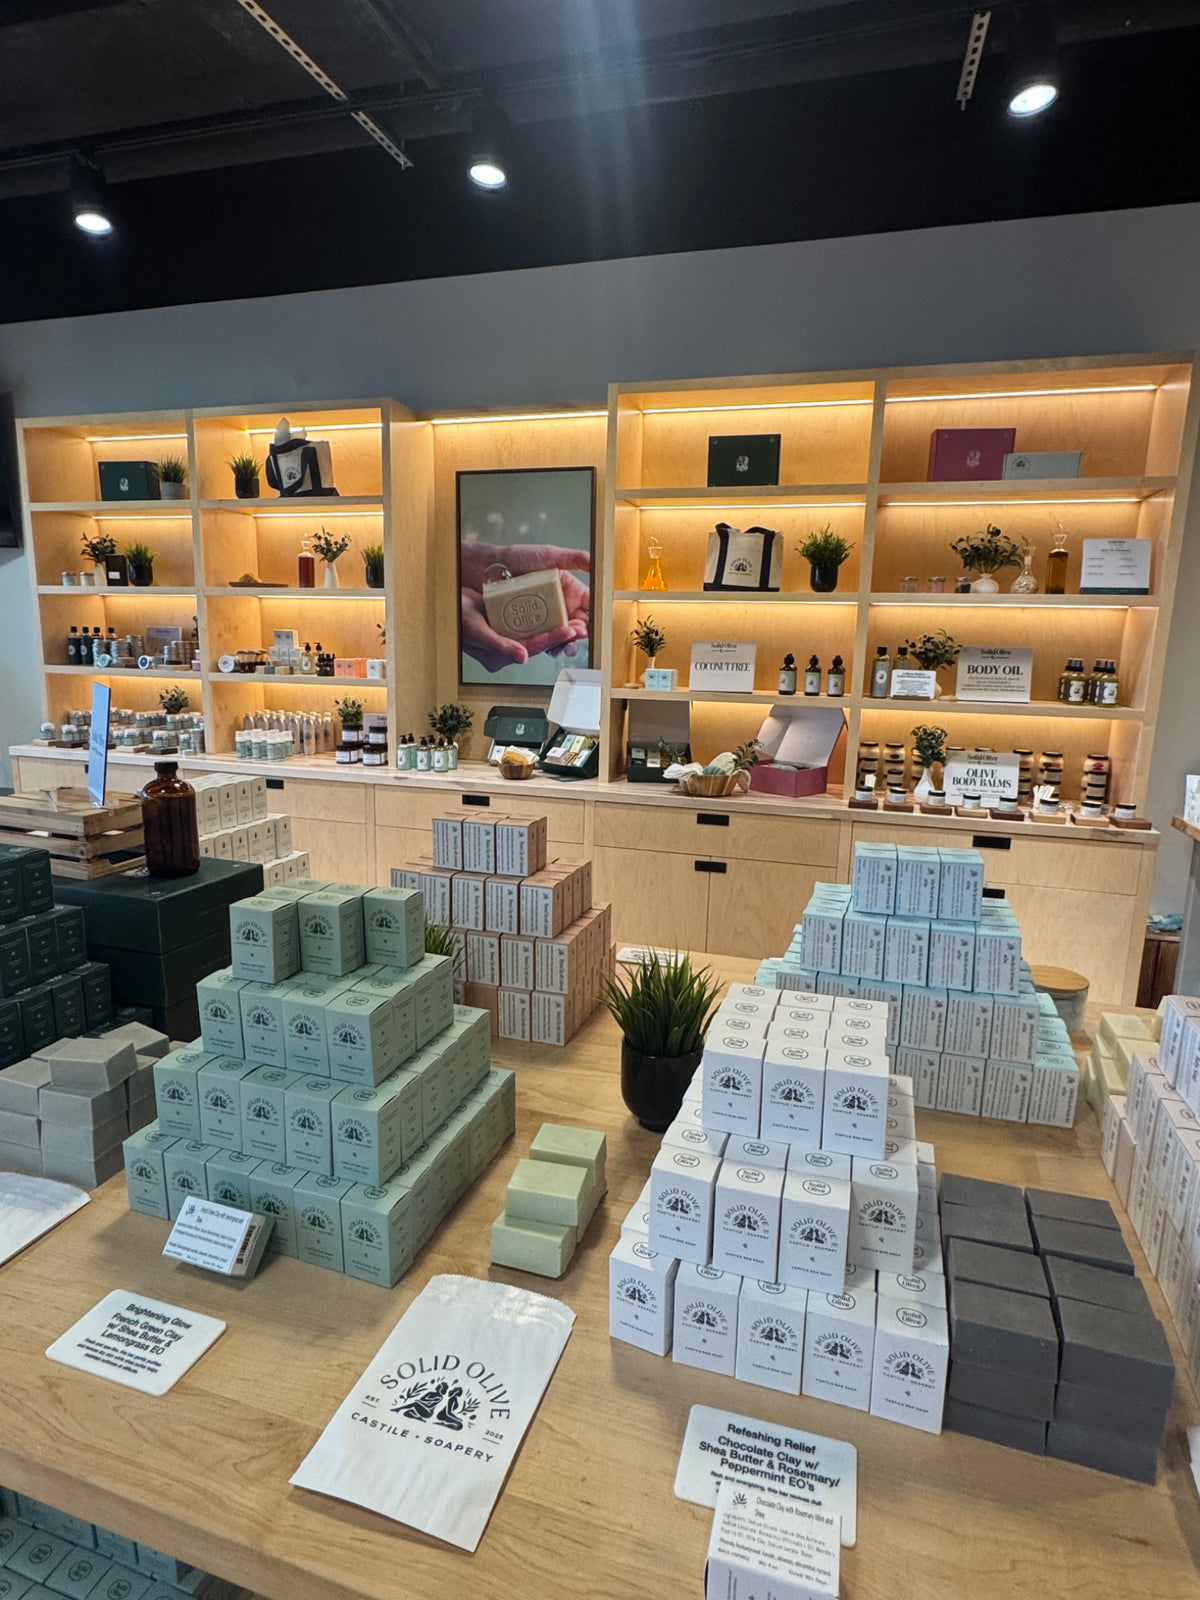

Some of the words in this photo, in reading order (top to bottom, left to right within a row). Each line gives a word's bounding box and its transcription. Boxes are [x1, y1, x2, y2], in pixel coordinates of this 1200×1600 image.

[511, 600, 538, 616] Solid
[512, 615, 540, 628] Olive
[695, 662, 731, 672] COCONUT
[732, 663, 750, 672] FREE
[968, 664, 1000, 676] BODY
[1002, 664, 1023, 676] OIL
[952, 777, 977, 786] BODY
[980, 780, 1012, 788] BALMS
[966, 768, 998, 778] OLIVE
[711, 1067, 730, 1080] SOLID
[732, 1068, 751, 1086] OLIVE
[771, 1079, 792, 1092] SOLID
[794, 1080, 814, 1097] OLIVE
[834, 1087, 855, 1101] SOLID
[857, 1088, 878, 1105] OLIVE
[659, 1188, 679, 1201] SOLID
[681, 1190, 700, 1210] OLIVE
[860, 1200, 883, 1214] SOLID
[885, 1202, 906, 1220] OLIVE
[724, 1204, 746, 1218] SOLID
[748, 1206, 769, 1226] OLIVE
[791, 1218, 814, 1232] SOLID
[816, 1219, 838, 1240] OLIVE
[618, 1278, 636, 1290] SOLID
[638, 1280, 656, 1300] OLIVE
[126, 1304, 170, 1324] Brightening
[171, 1318, 192, 1330] Glow
[684, 1301, 704, 1314] SOLID
[707, 1303, 728, 1322] OLIVE
[107, 1322, 118, 1330] w/
[118, 1325, 138, 1337] Shea
[140, 1332, 164, 1346] Butter
[164, 1340, 173, 1348] &
[112, 1312, 139, 1328] French
[140, 1322, 164, 1335] Green
[164, 1330, 184, 1342] Clay
[751, 1317, 773, 1330] SOLID
[776, 1319, 797, 1338] OLIVE
[101, 1330, 150, 1350] Lemongrass
[150, 1347, 165, 1355] EO
[816, 1332, 838, 1346] SOLID
[841, 1334, 862, 1356] OLIVE
[886, 1351, 910, 1364] SOLID
[912, 1354, 935, 1375] OLIVE
[380, 1354, 460, 1390] SOLID
[466, 1362, 510, 1420] OLIVE
[351, 1412, 410, 1438] CASTILE
[424, 1436, 494, 1462] SOAPERY
[728, 1424, 781, 1447] Refeshing
[784, 1438, 816, 1454] Relief
[700, 1441, 726, 1456] Shea
[730, 1450, 763, 1466] Butter
[767, 1460, 774, 1469] &
[778, 1462, 840, 1487] Rosemary/
[718, 1436, 774, 1458] Chocolate
[777, 1451, 800, 1468] Clay
[805, 1461, 819, 1470] w/
[720, 1458, 785, 1484] Peppermint
[789, 1477, 815, 1492] EO's
